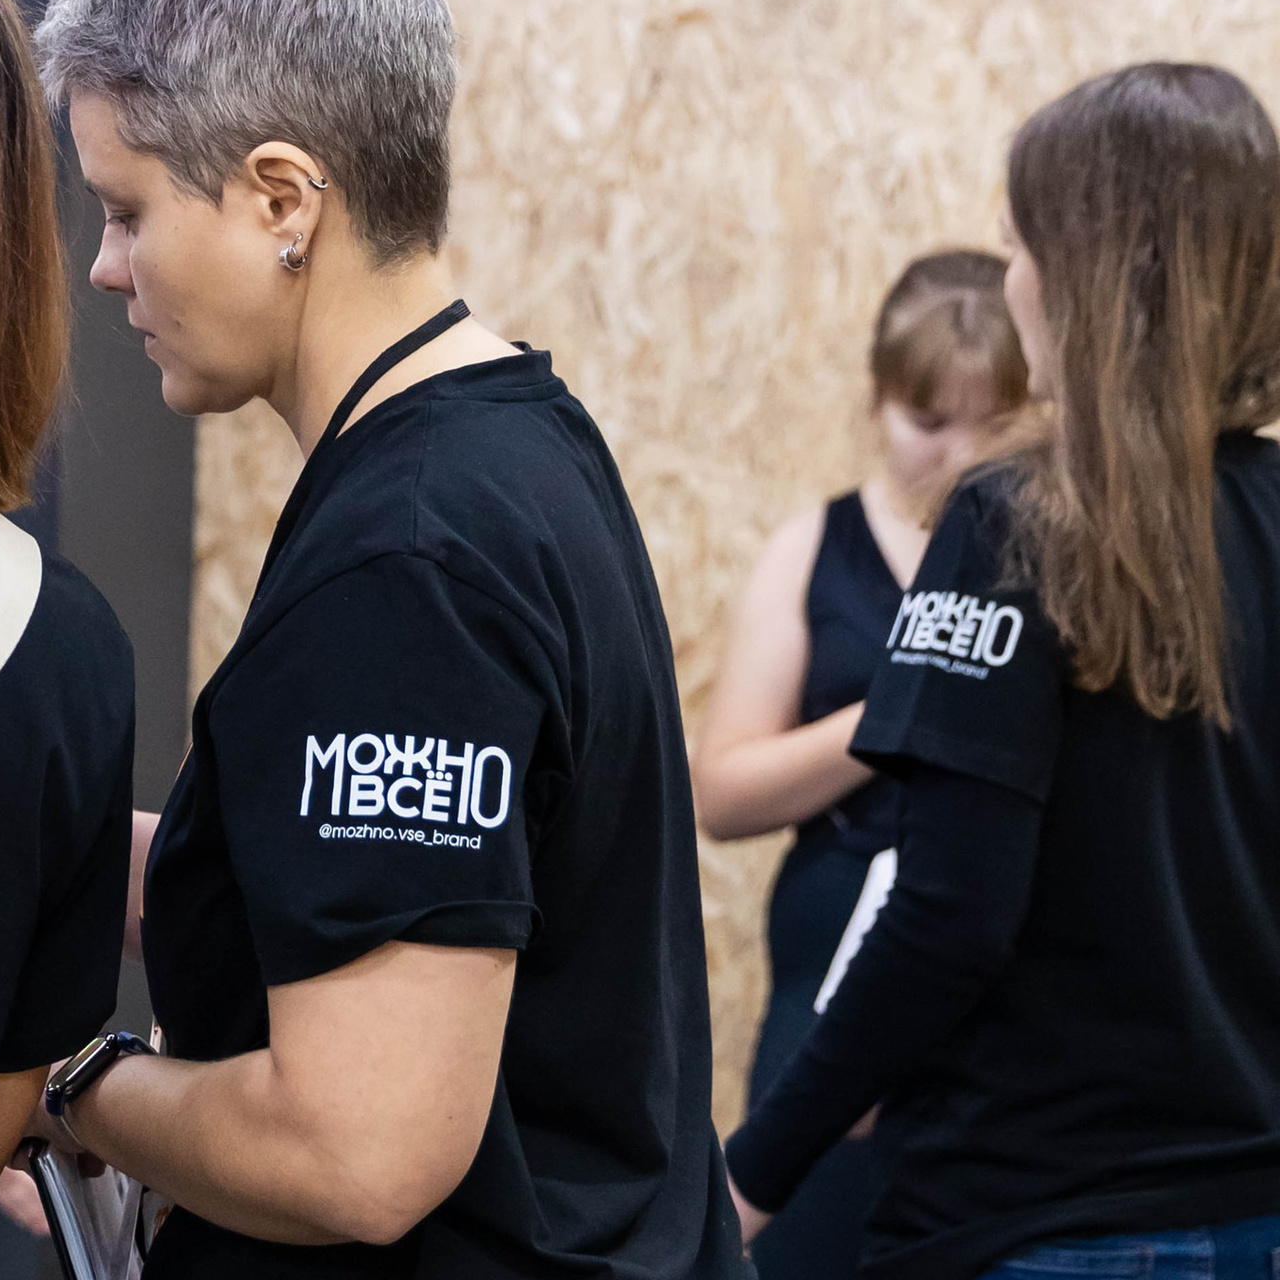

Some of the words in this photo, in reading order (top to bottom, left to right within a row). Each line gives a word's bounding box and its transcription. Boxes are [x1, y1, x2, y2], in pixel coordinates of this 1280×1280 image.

[299, 732, 513, 829] МОЖНО
[348, 769, 454, 823] ВСЁ
[318, 822, 482, 850] @mozhno.vse_brand
